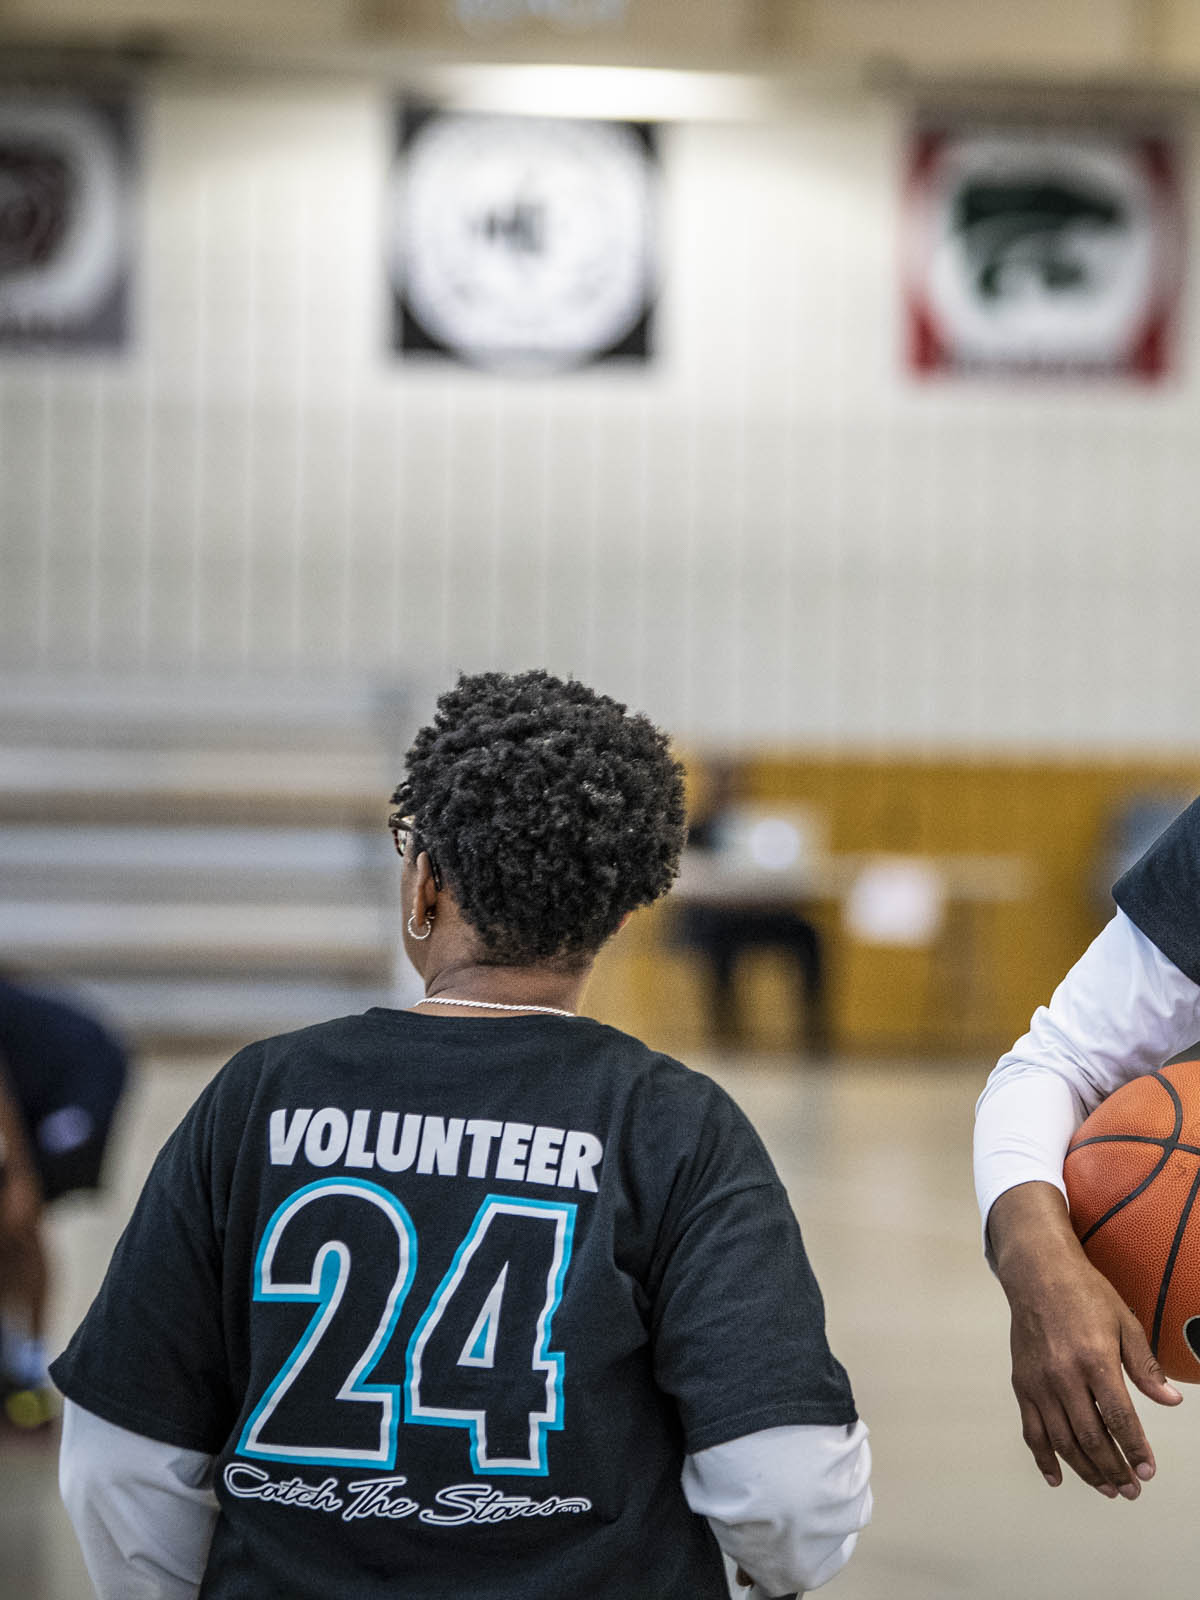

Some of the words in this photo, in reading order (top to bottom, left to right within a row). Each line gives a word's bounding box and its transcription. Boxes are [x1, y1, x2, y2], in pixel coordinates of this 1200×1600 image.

[269, 1107, 604, 1193] VOLUNTEER
[235, 1176, 578, 1477] 24
[223, 1462, 344, 1512] Catch
[341, 1476, 420, 1522] The
